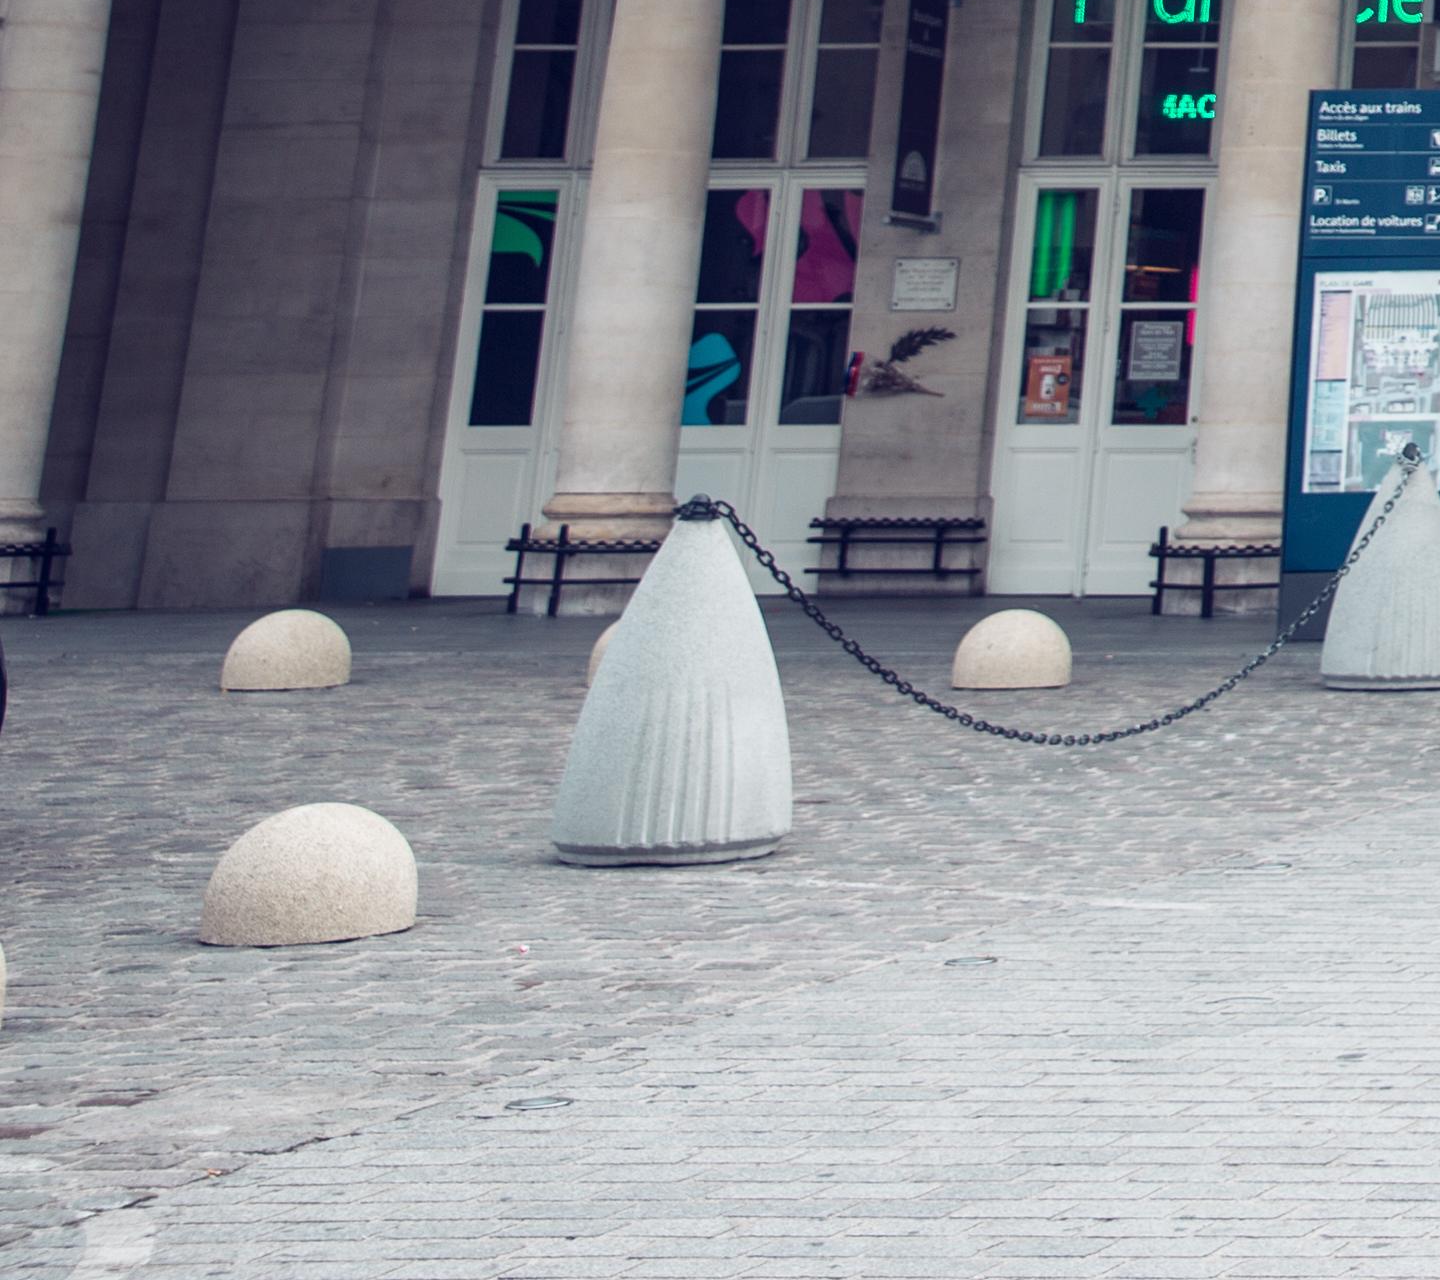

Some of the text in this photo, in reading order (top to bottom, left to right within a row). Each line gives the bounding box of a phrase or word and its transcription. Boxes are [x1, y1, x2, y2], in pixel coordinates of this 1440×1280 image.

[1319, 101, 1422, 114] Accès aux trains
[1316, 129, 1357, 142] Billets
[1315, 160, 1347, 174] Taxis
[1310, 215, 1423, 226] Location de voitures
